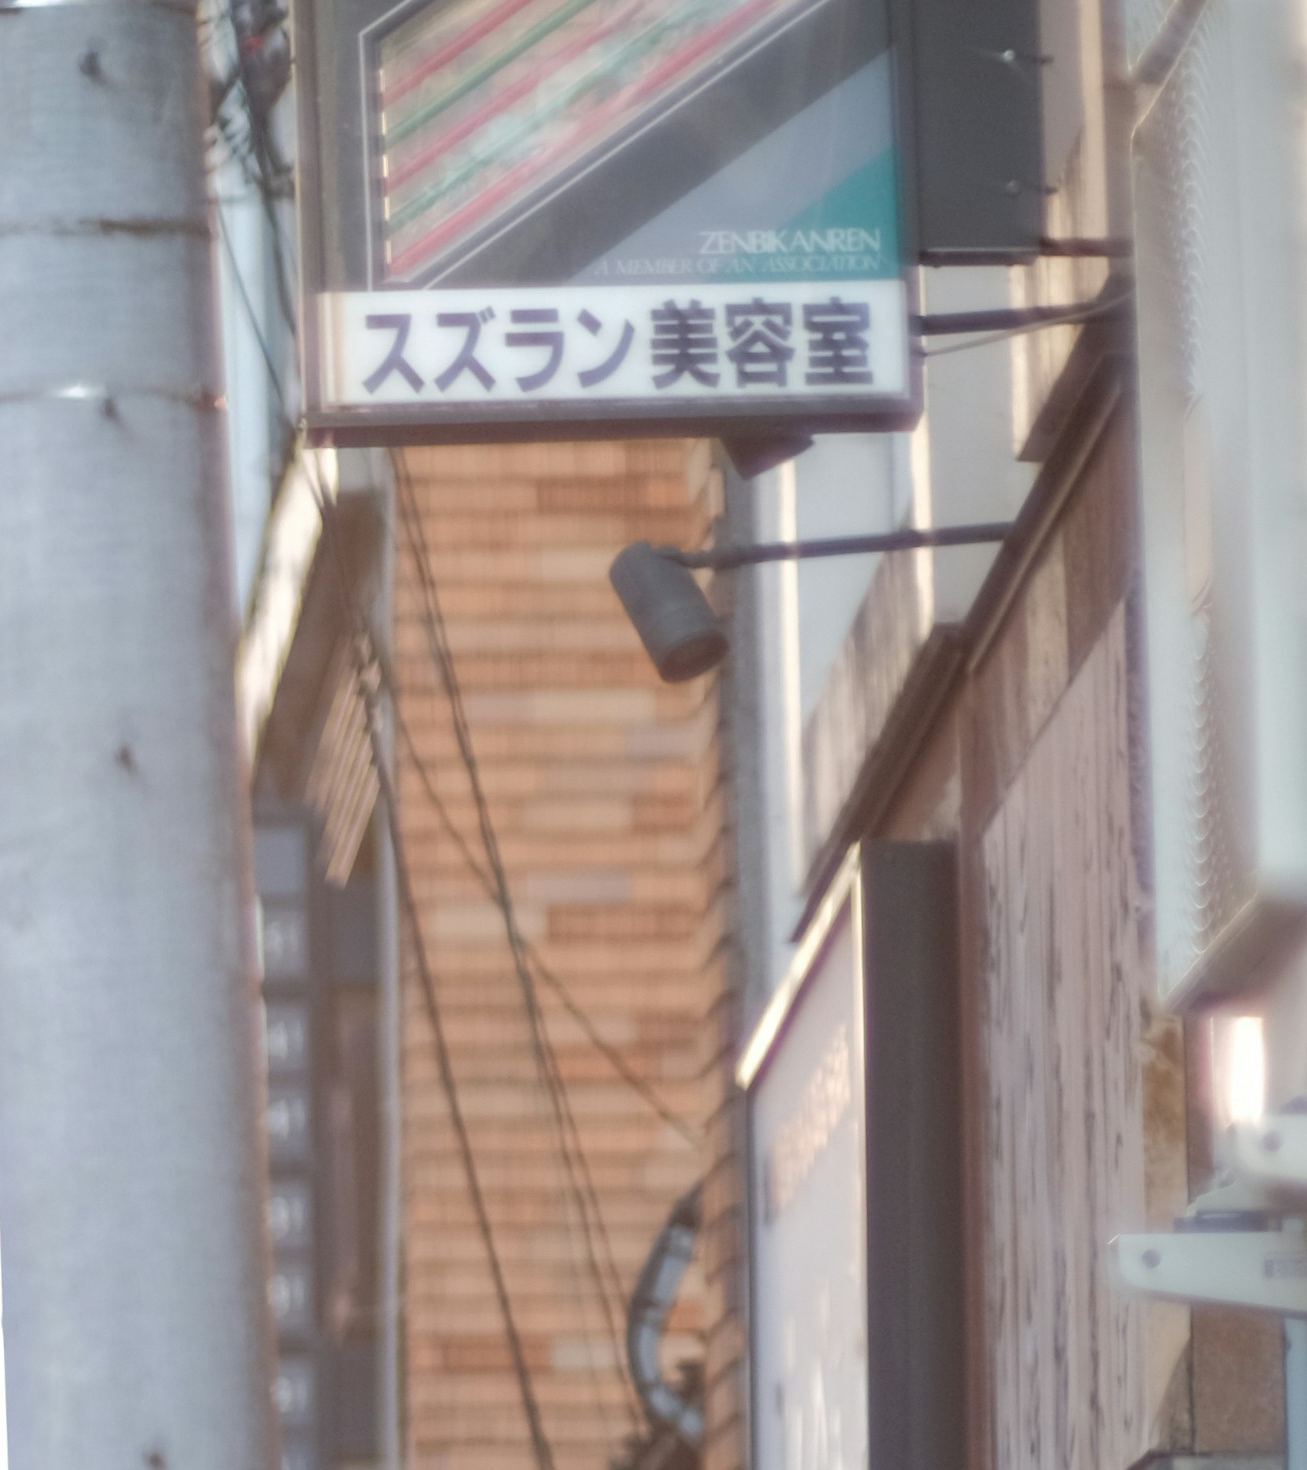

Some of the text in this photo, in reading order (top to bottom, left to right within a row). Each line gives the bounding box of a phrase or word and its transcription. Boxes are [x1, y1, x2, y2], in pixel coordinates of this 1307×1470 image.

[699, 228, 881, 254] ZENBIKANREN
[361, 296, 875, 393] スズラン美容室
